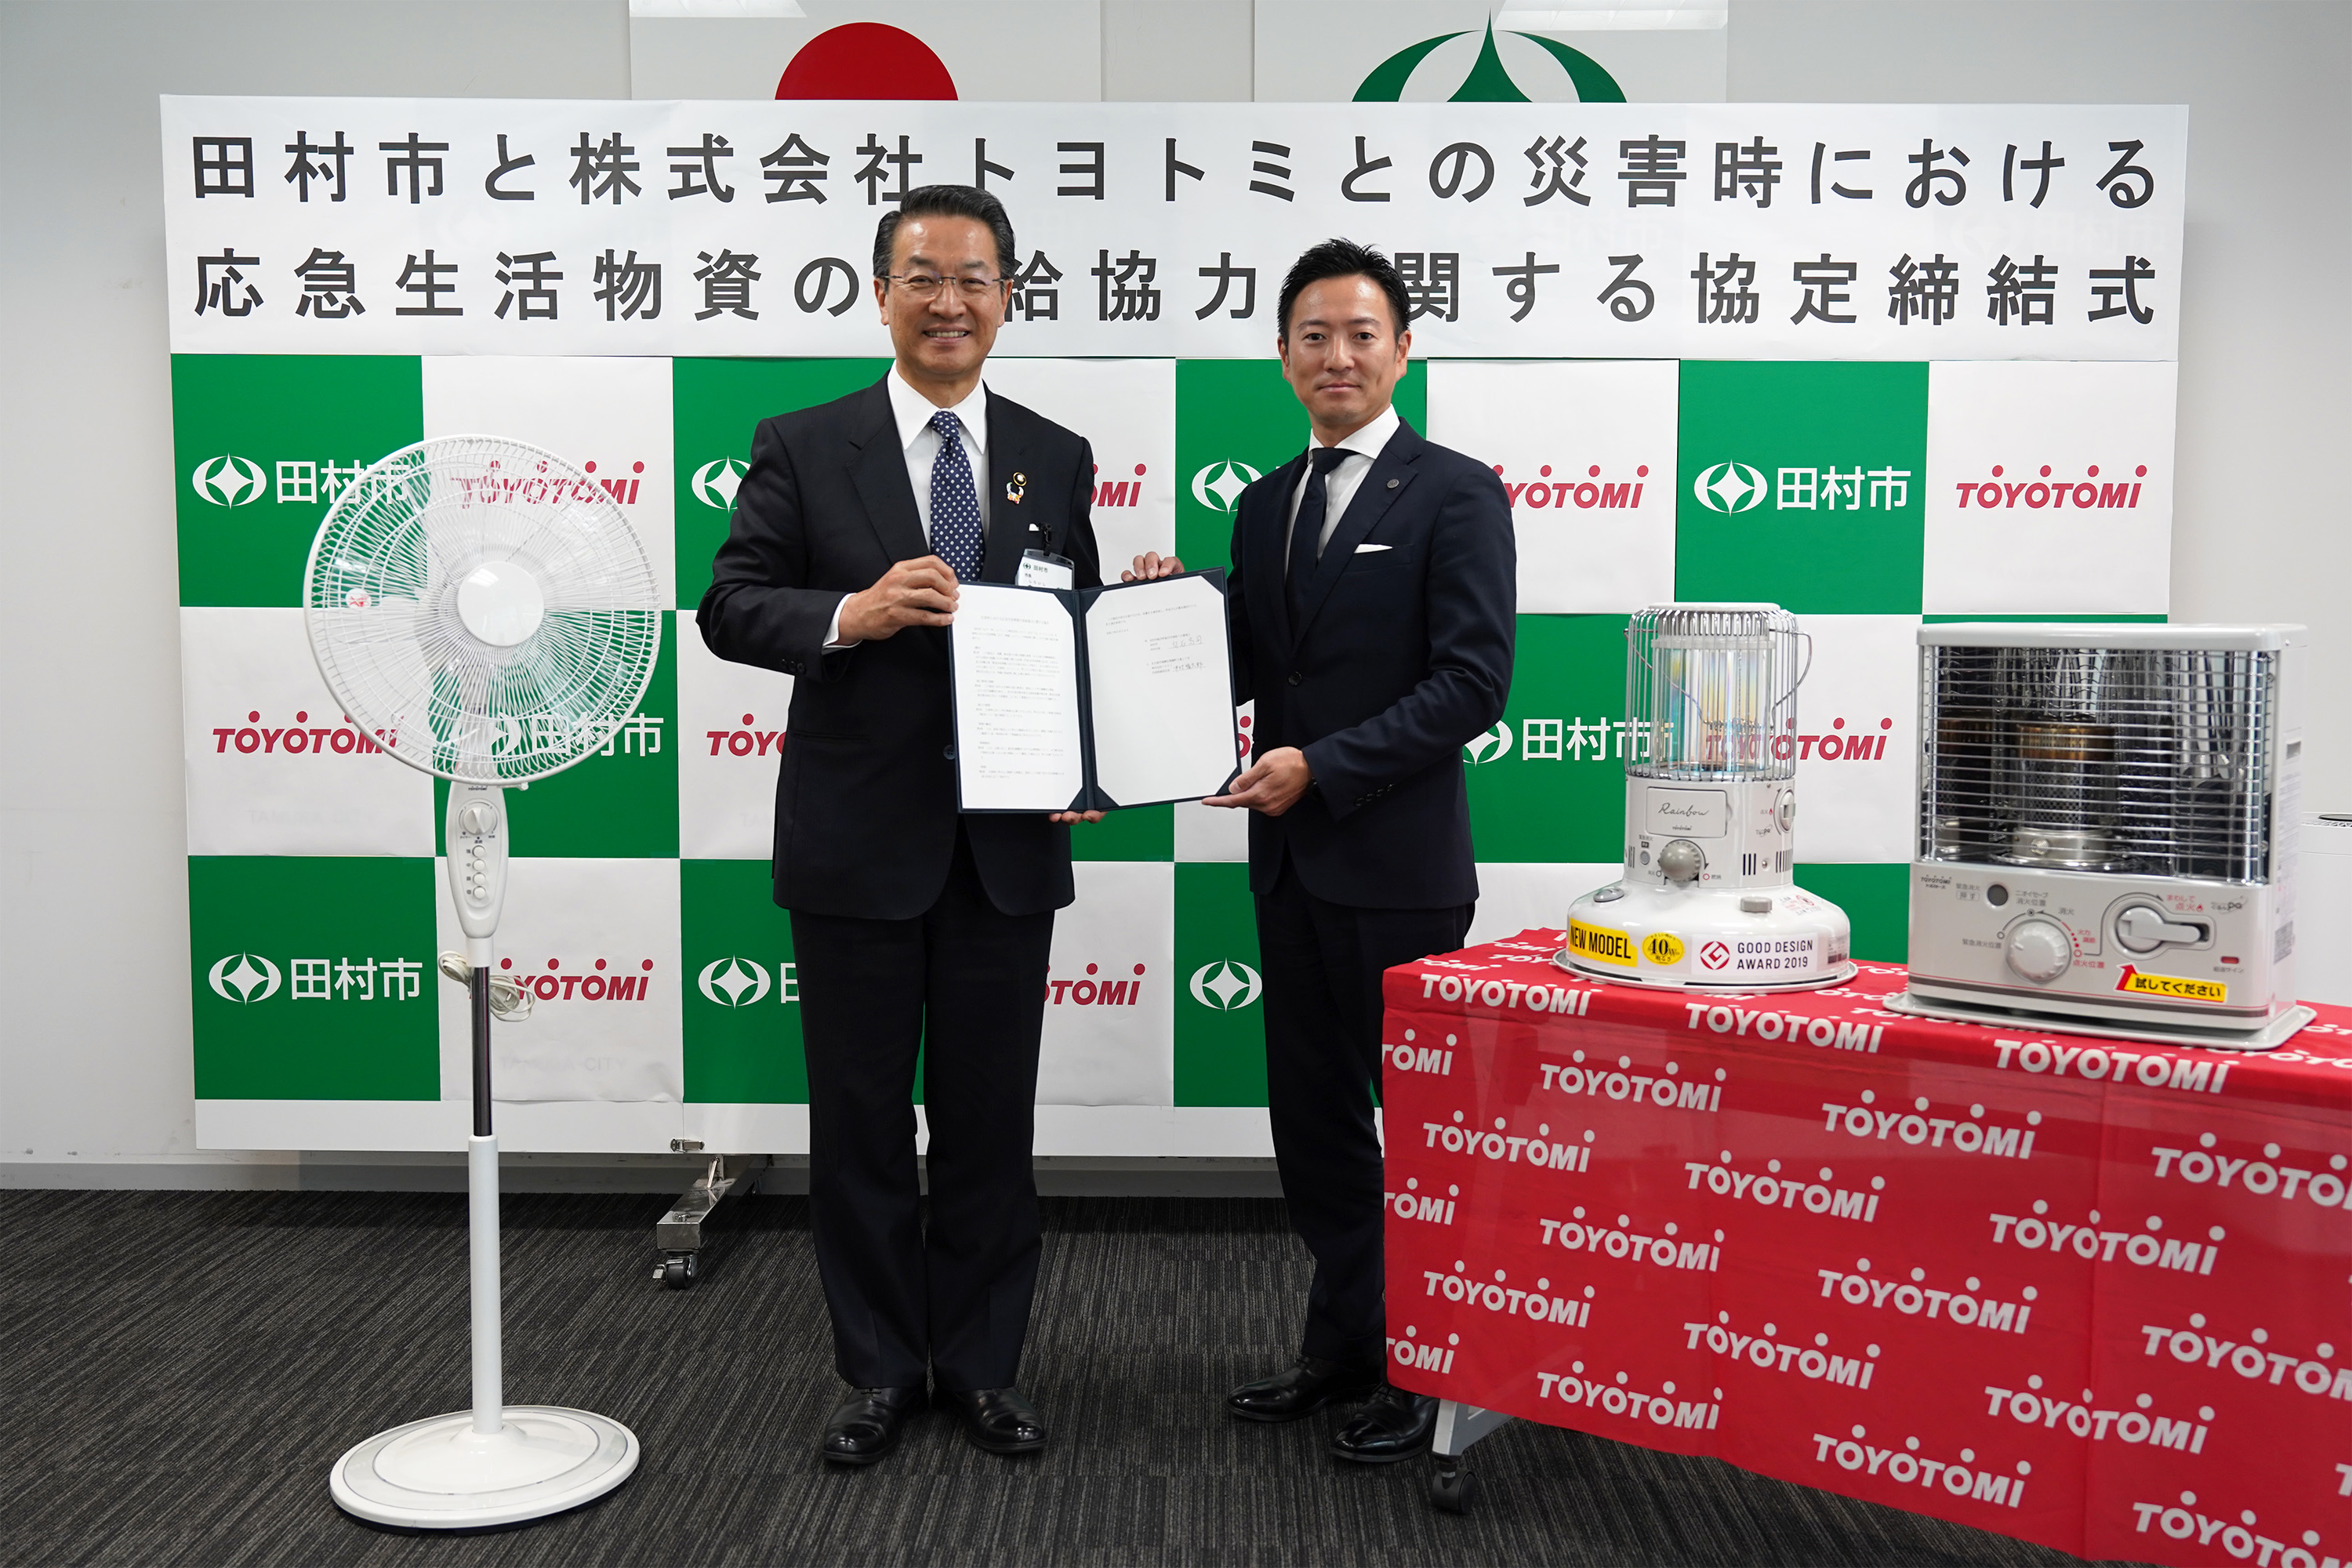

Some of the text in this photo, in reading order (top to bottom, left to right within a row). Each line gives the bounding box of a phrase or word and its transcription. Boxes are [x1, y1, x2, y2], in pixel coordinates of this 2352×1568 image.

[193, 131, 2155, 209] 田村市と株式会社トヨトミとの災害時における
[194, 248, 2156, 325] 応急生活物資の給協力関する協定締結式
[1493, 465, 1649, 508] YOTOMI
[1777, 466, 1911, 510] 田村市
[1957, 465, 2147, 508] TOYOTOMI
[1658, 802, 1709, 817] Rainbow
[1920, 875, 1952, 884] TOYOTOMI
[2176, 903, 2194, 912] 点火
[1570, 925, 1632, 960] NEW MODEL
[1737, 942, 1771, 954] GOOD
[1775, 940, 1813, 953] DESIGN
[1737, 956, 1809, 971] AWARD 2019
[291, 958, 423, 1001] 田村市
[470, 958, 653, 1000] YOTOMI
[1045, 963, 1145, 1005] TOMI
[1421, 974, 1602, 1016] TOYOTOMI
[2135, 977, 2221, 997] 試してください
[1686, 1003, 1894, 1053] TOYOTOMI
[1541, 1050, 1726, 1112] TOYOTOMI
[1994, 1040, 2241, 1094] TOYOTOMI
[1424, 1110, 1595, 1173] TOYOTOMI
[1822, 1090, 2041, 1159] TOYOTOMI
[1685, 1150, 1885, 1221] TOYOTOMI
[2152, 1132, 2352, 1210] TOYOTO
[1540, 1207, 1724, 1272] TOYOTOMI
[1989, 1200, 2225, 1275] TOYOTOMI
[1424, 1261, 1595, 1327] TOYOTOMI
[1818, 1258, 2037, 1334] TOYOTOMI
[1684, 1311, 1880, 1389] TOYOTOMI
[1537, 1361, 1722, 1430] TOYOTOMI
[1984, 1375, 2214, 1454] TOYOTOMI
[1813, 1425, 2031, 1508] TOYOTOMI
[2132, 1490, 2352, 1568] TOYOTO
